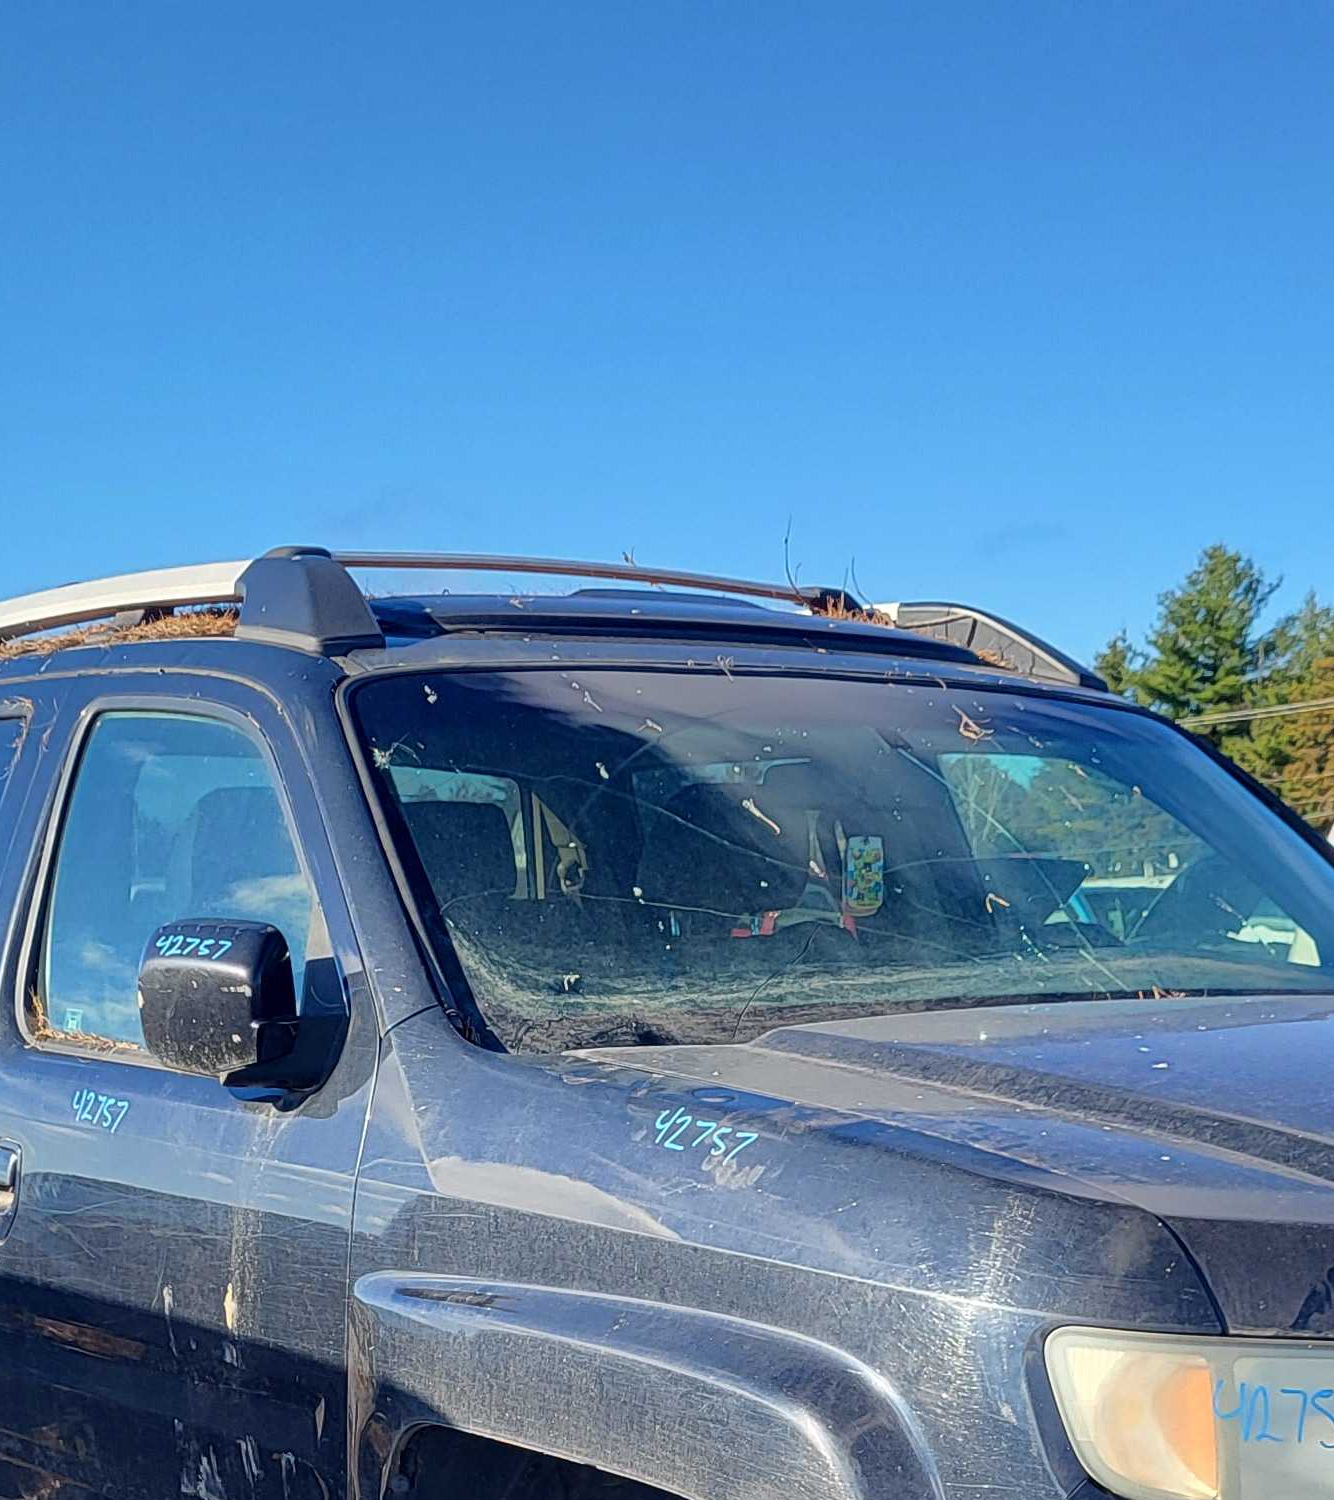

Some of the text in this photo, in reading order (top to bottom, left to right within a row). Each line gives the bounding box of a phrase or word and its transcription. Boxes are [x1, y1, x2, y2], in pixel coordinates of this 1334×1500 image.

[155, 934, 233, 960] 42757
[72, 1089, 129, 1134] 42757
[654, 1106, 759, 1167] 42757
